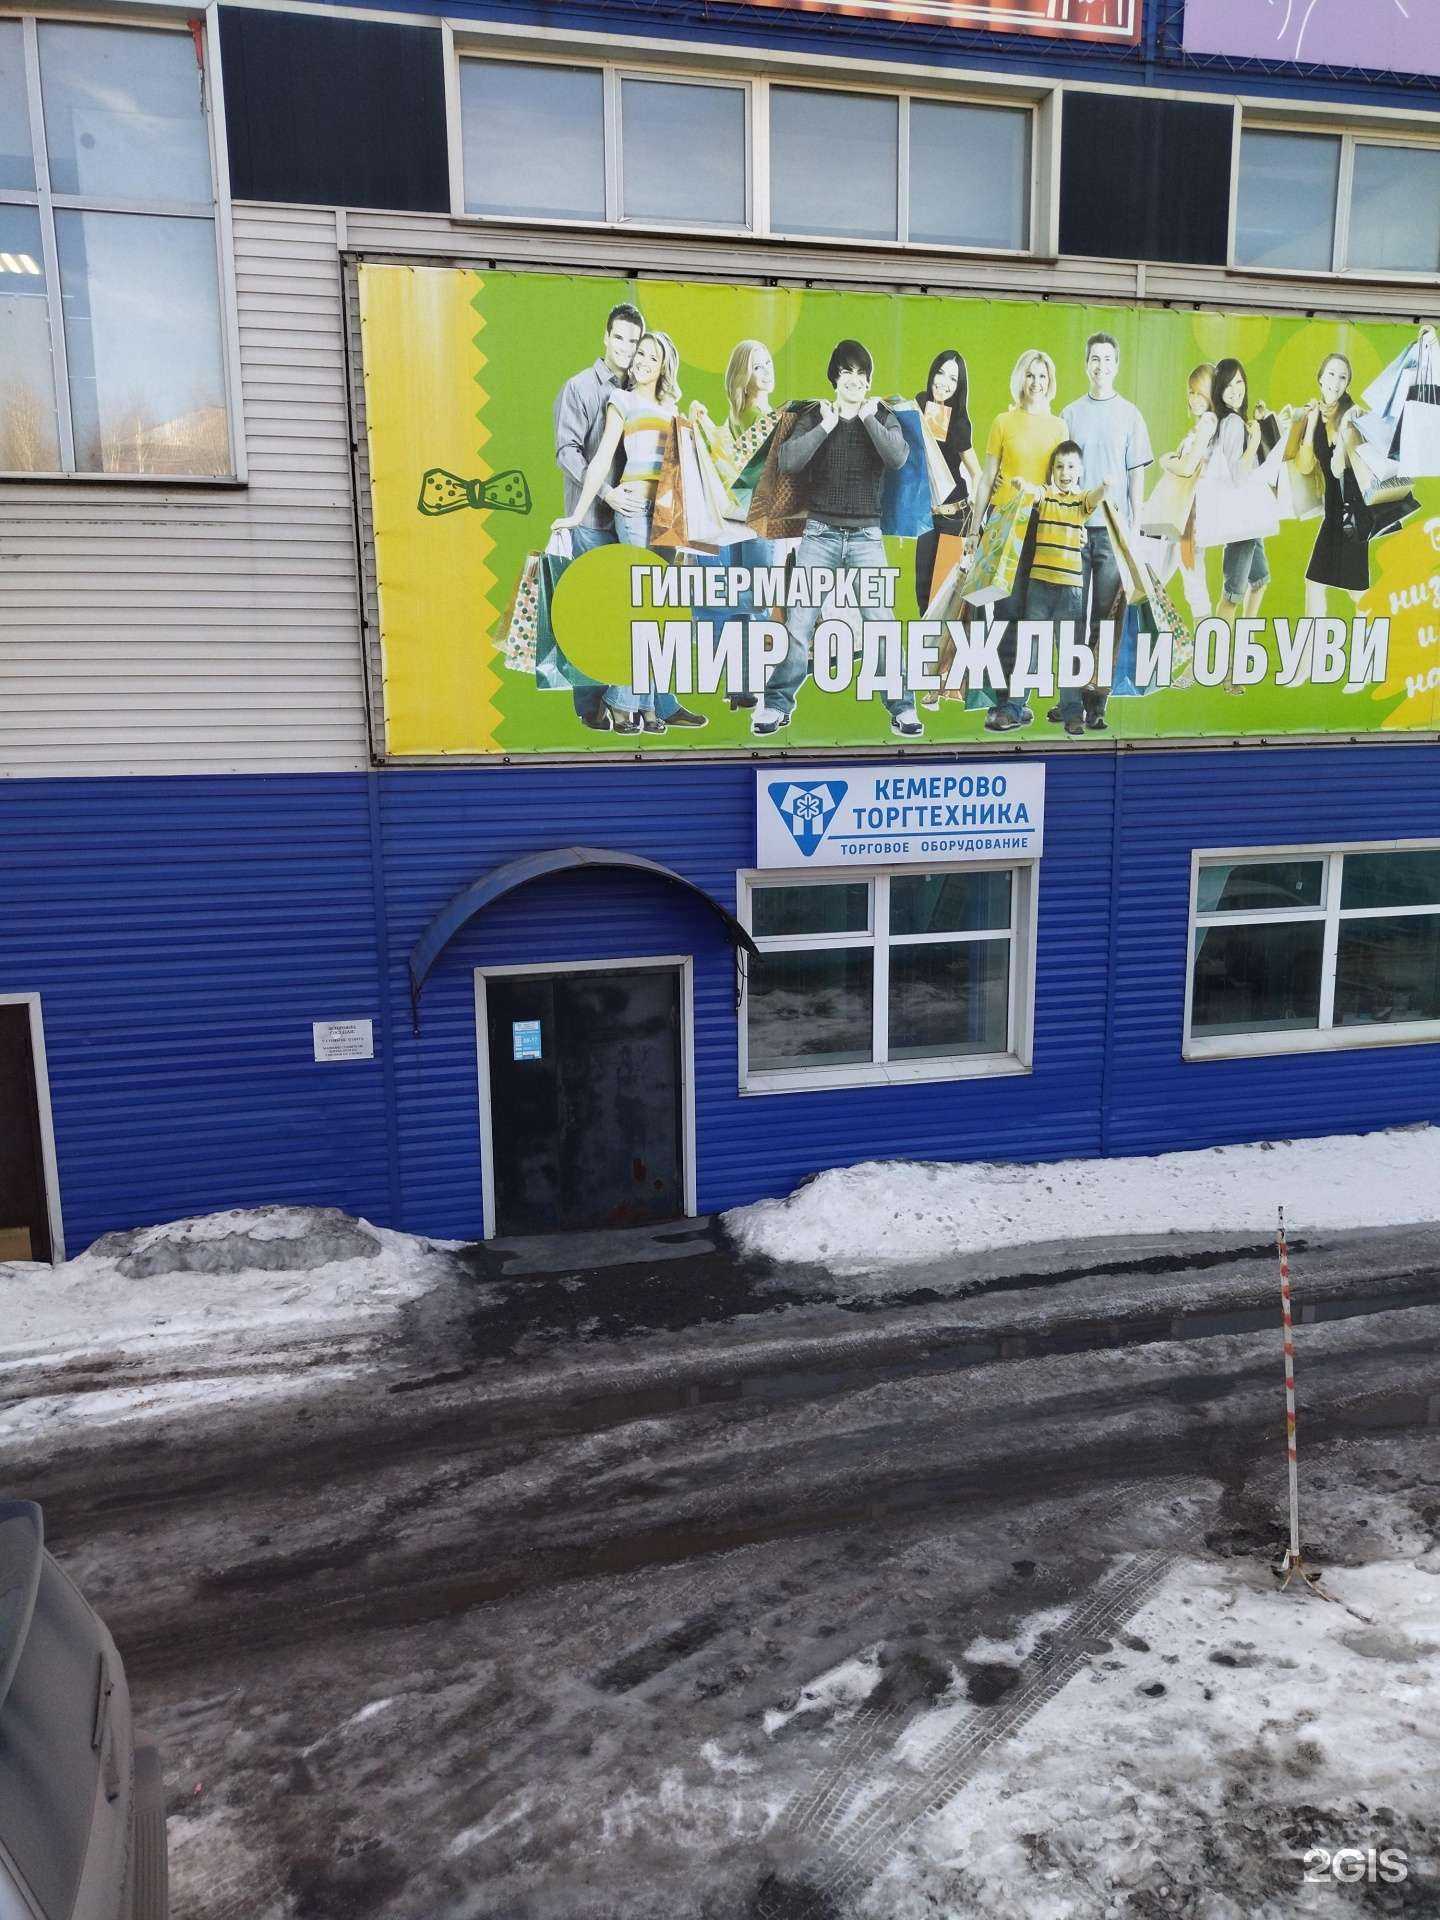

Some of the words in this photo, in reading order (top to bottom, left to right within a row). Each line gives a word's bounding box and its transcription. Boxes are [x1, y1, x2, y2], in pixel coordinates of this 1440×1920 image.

[630, 564, 900, 608] ГИПЕРМАРКЕТ
[630, 620, 790, 694] МИР
[812, 618, 1116, 701] ОДЕЖДЫ
[1192, 616, 1391, 688] ОБУВИ
[875, 775, 1007, 801] КЕМЕРОВО
[852, 803, 1030, 830] ТОРГТЕХНИКА
[840, 842, 910, 855] ТОРГОВОЕ
[920, 837, 1029, 852] ОБОРУДОВАНИЕ
